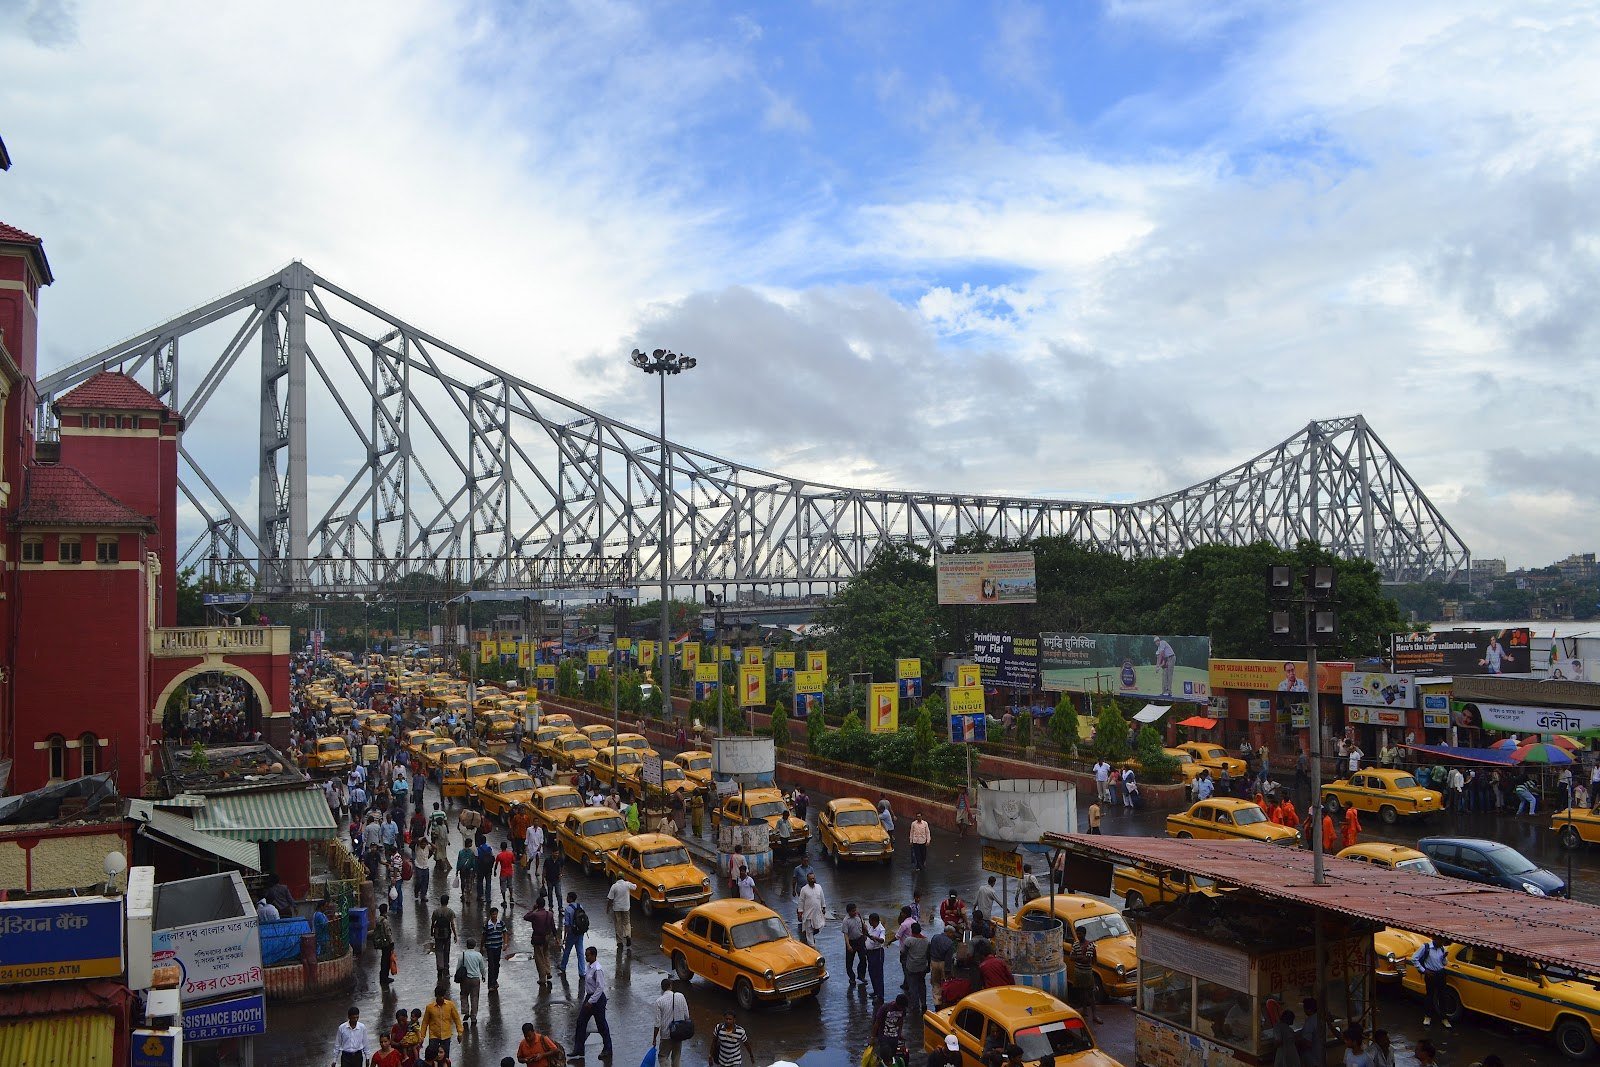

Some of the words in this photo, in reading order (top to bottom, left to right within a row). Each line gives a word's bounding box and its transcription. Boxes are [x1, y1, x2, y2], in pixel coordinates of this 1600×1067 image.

[974, 632, 1001, 644] Printing
[1002, 635, 1011, 643] on
[1043, 636, 1063, 650] समृद्धि
[1064, 636, 1096, 651] सुनिश्चित
[1396, 635, 1404, 643] No
[974, 644, 986, 654] any
[990, 643, 1004, 653] Flat
[1396, 643, 1413, 652] Here's
[1414, 643, 1424, 651] the
[1424, 642, 1437, 652] truly
[1438, 642, 1464, 650] unlimited
[1464, 641, 1477, 651] plan.
[974, 653, 1001, 664] Surface
[1227, 664, 1244, 672] SEXUAL
[1244, 665, 1261, 673] HEALTH
[1262, 665, 1277, 673] CLINIC
[1194, 683, 1206, 695] LIC
[953, 703, 982, 711] UNIQUE
[1536, 711, 1581, 732] এলীন
[55, 912, 89, 930] बैंक
[158, 930, 184, 943] বাংলার
[186, 929, 198, 943] দুধ
[200, 925, 225, 937] বাংলার
[227, 922, 242, 932] ঘরে
[244, 920, 258, 929] ঘরে
[1, 970, 14, 979] 24
[16, 966, 55, 978] HOURS
[58, 964, 81, 976] ATM
[186, 976, 218, 994] ঠক্কর
[219, 966, 262, 989] ডেয়ারী
[181, 1011, 229, 1029] SSISTANCE
[231, 1007, 262, 1024] BOOTH
[189, 1028, 218, 1039] G.R.P.
[220, 1024, 256, 1035] Traffic
